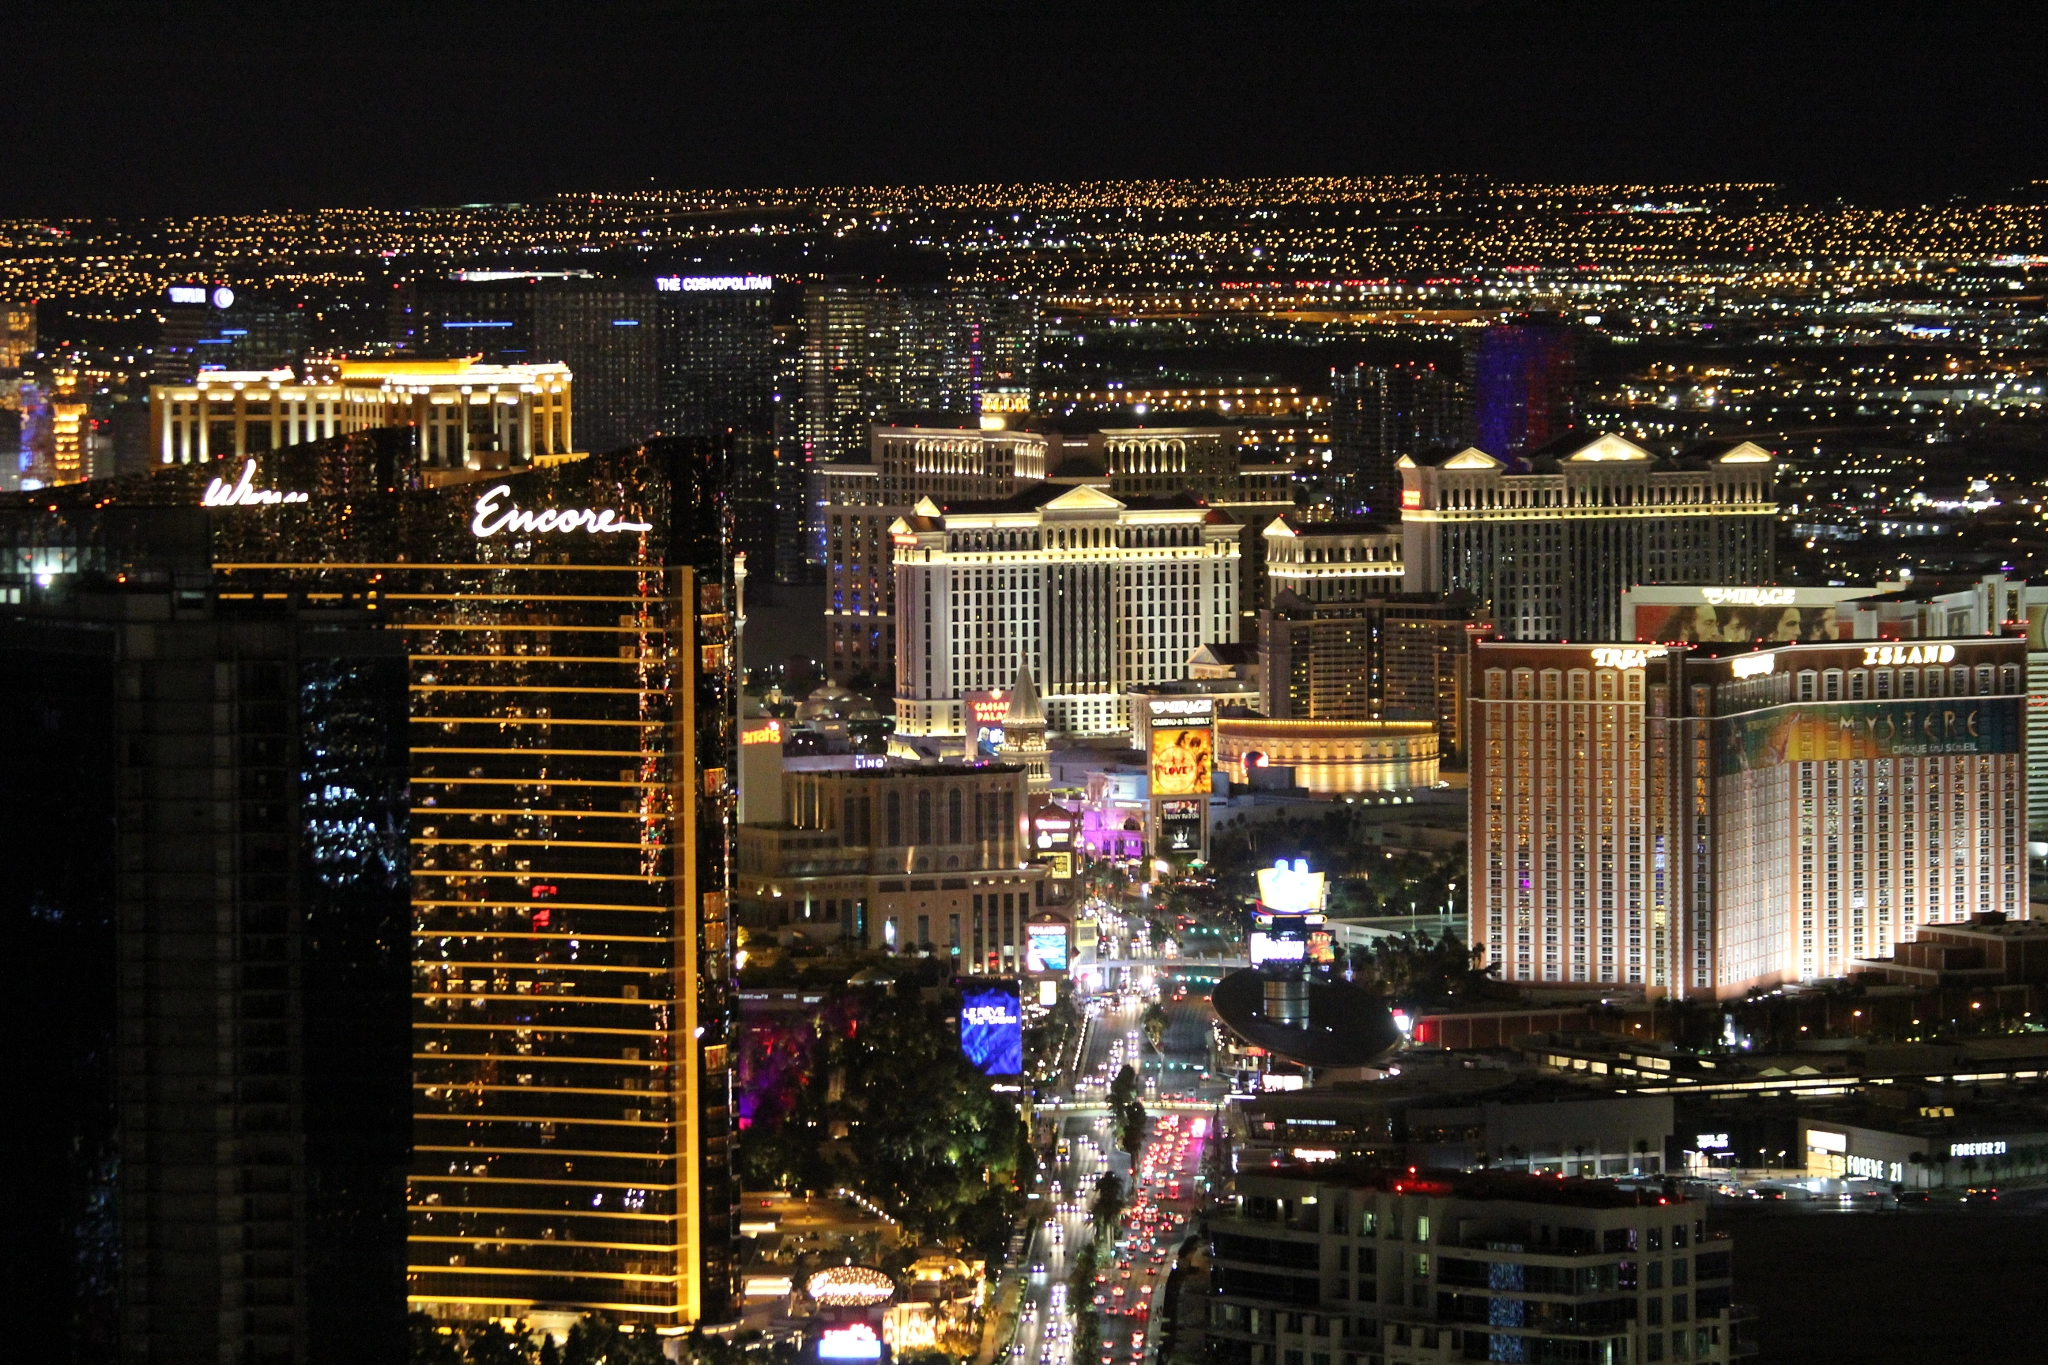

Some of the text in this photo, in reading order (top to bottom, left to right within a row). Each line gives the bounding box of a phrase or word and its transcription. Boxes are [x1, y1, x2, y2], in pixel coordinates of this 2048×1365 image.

[657, 277, 772, 291] THE COSMOPOLITAN
[473, 484, 653, 537] Encore
[1708, 588, 1796, 606] MIRAGE
[1863, 645, 1956, 666] ISLAND
[855, 758, 884, 769] LINQ
[1165, 765, 1188, 775] LOVE
[1950, 1141, 2007, 1157] FOREVER 21
[1890, 1162, 1902, 1182] 21
